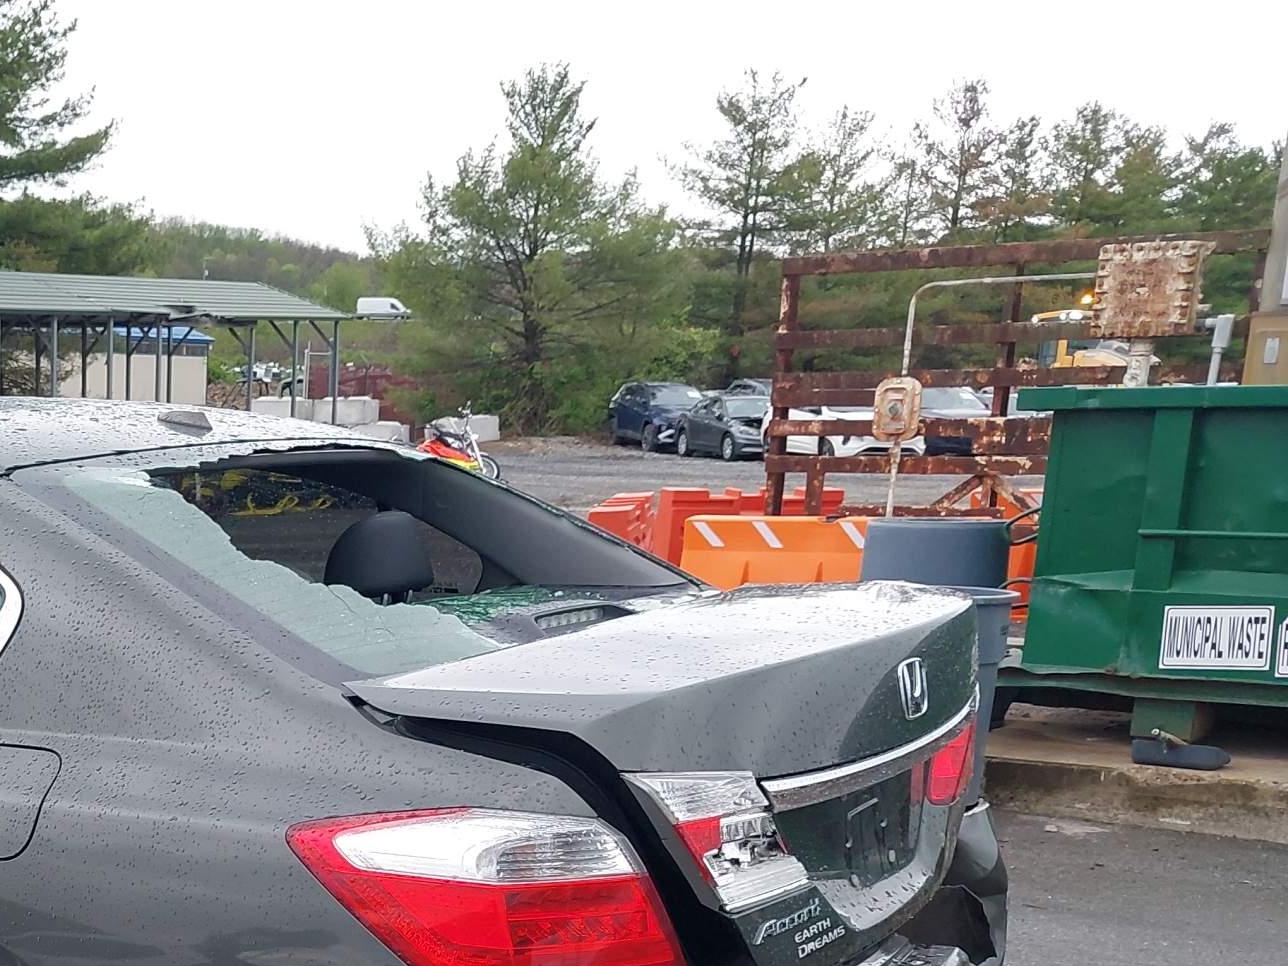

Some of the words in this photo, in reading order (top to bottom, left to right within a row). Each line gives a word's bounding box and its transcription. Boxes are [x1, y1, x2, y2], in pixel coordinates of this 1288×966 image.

[1166, 616, 1224, 659] MUNICIPAL
[1227, 616, 1267, 659] WASTE
[752, 897, 822, 945] Accord
[794, 917, 831, 943] EARTH
[797, 925, 846, 959] DREAMS
